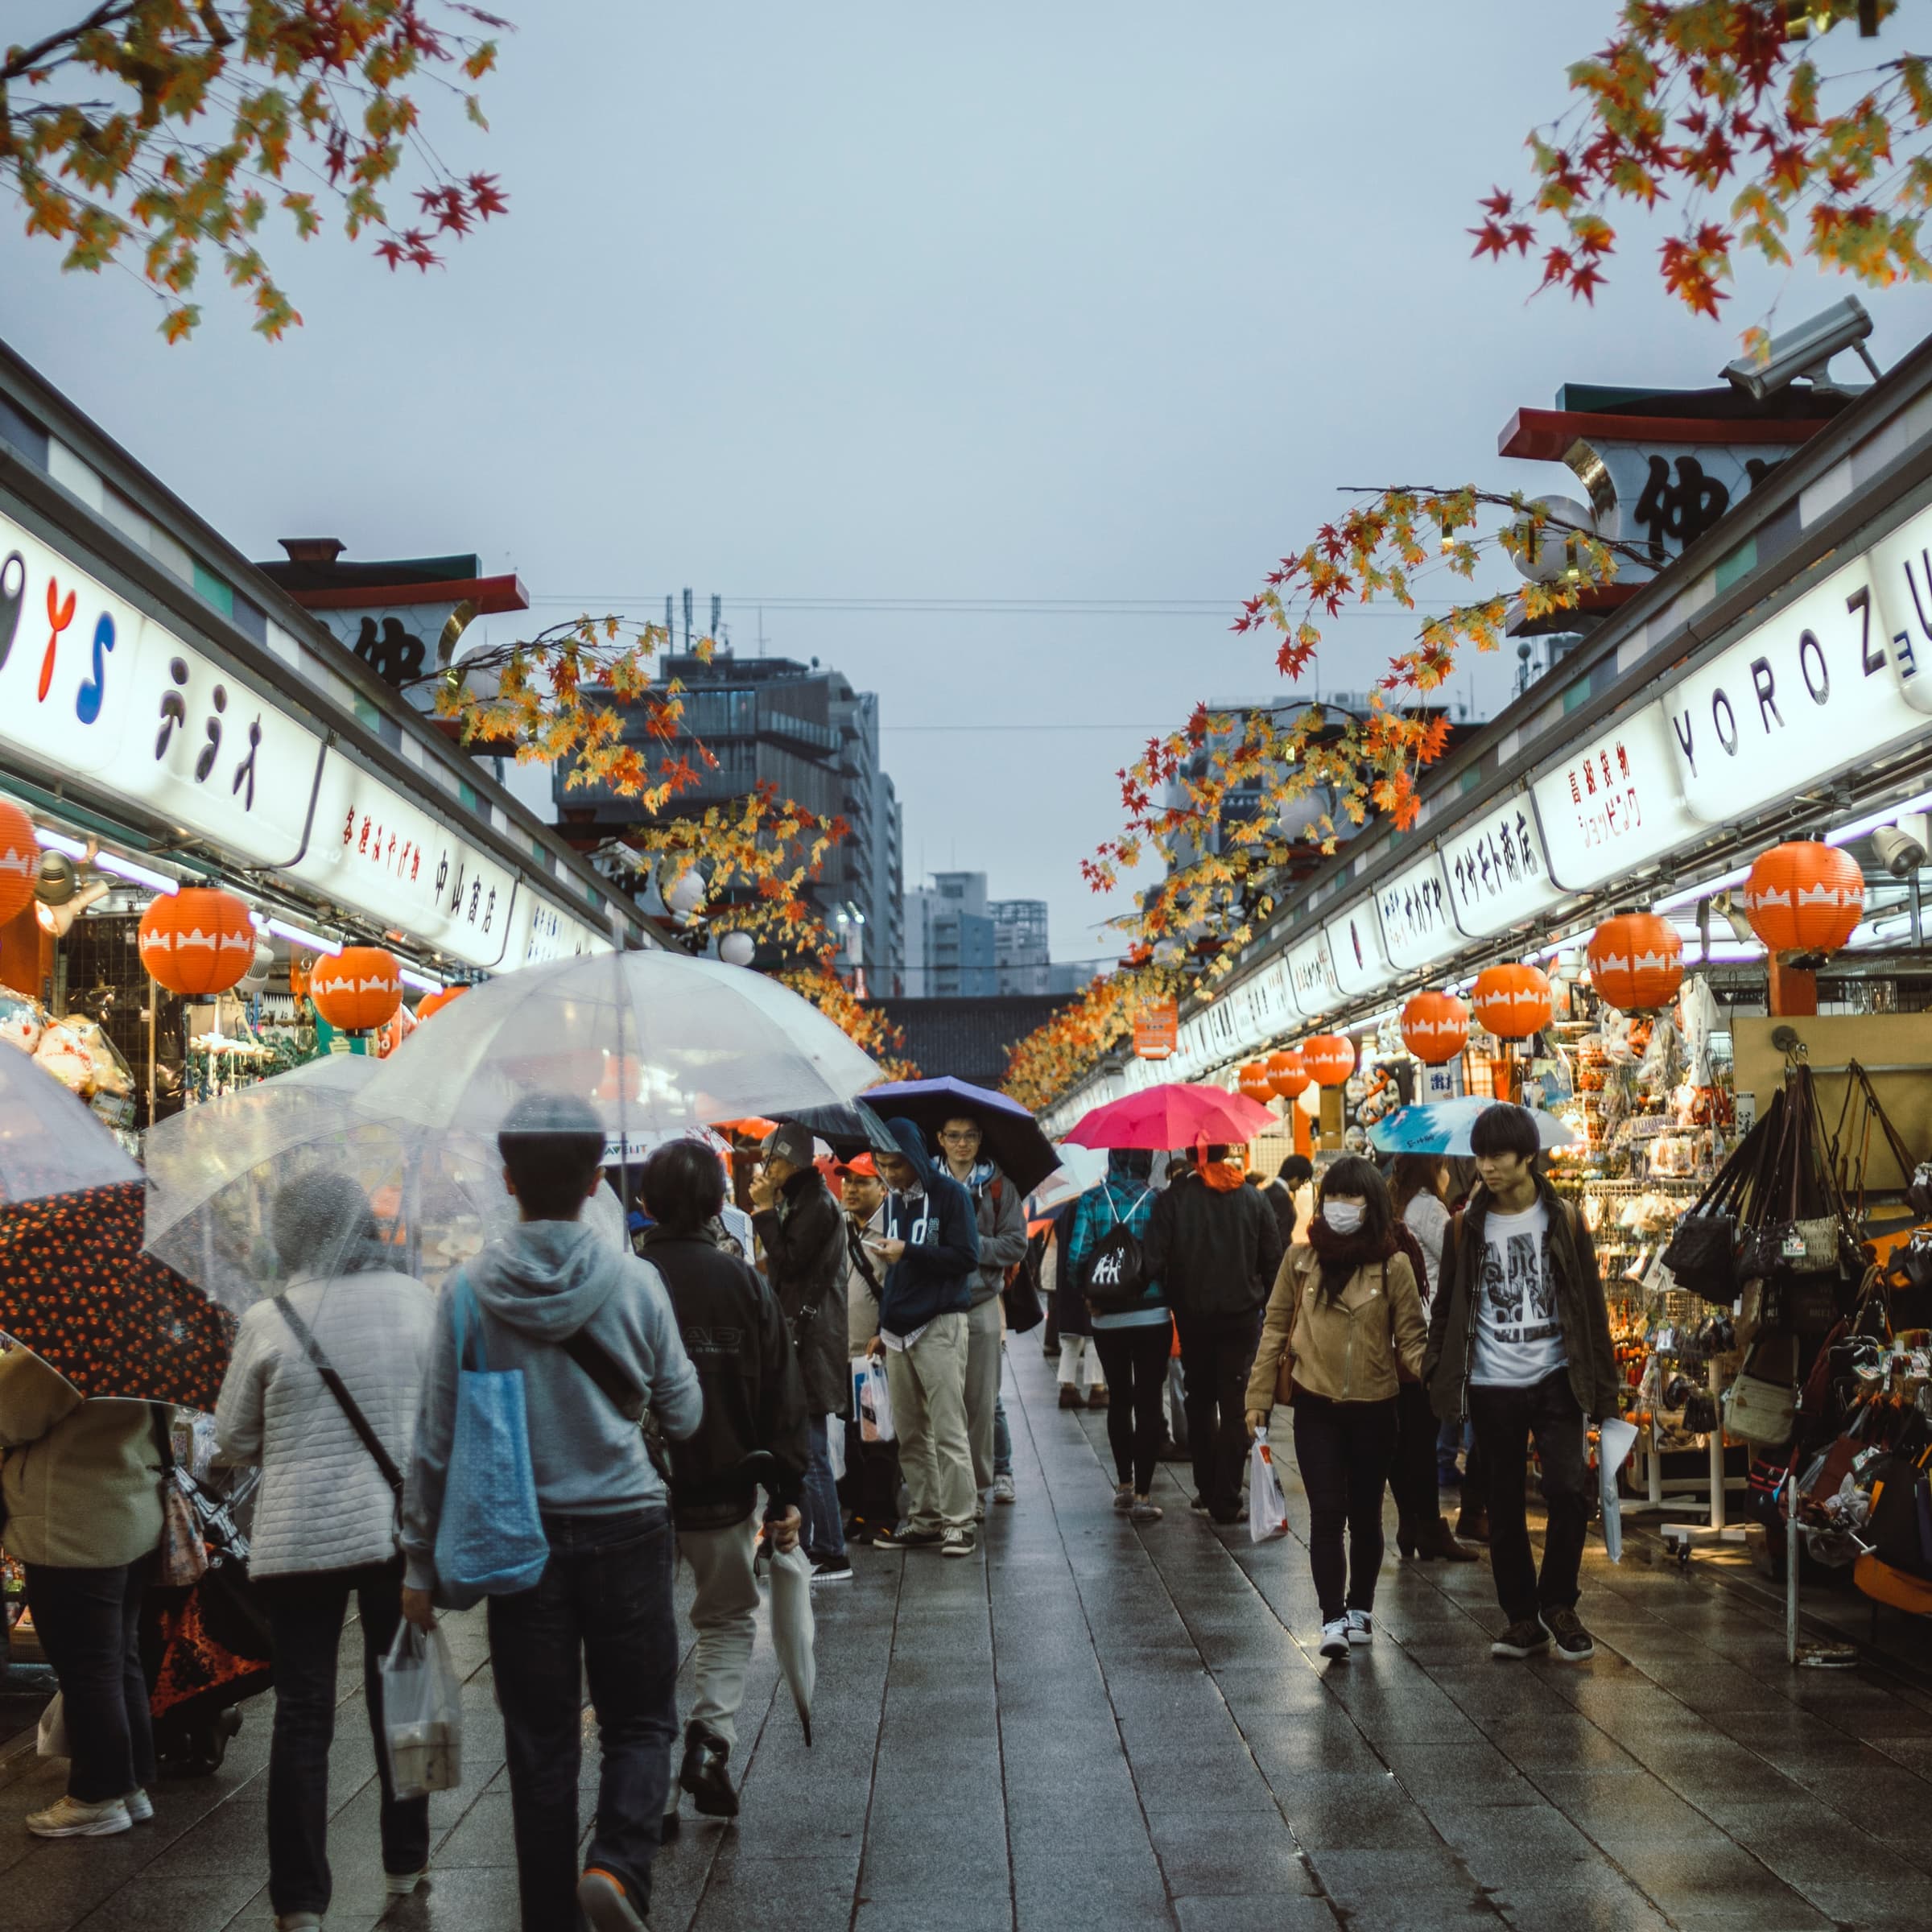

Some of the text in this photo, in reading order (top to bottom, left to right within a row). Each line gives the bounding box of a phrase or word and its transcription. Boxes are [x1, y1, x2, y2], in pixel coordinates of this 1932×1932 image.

[1634, 456, 1789, 562] 仲
[319, 617, 425, 688] 仲
[1568, 741, 1630, 805] 高級袋物
[1578, 786, 1641, 848] ショッピング
[343, 804, 420, 882] 各種みやげ物
[436, 848, 496, 935] 中山商店
